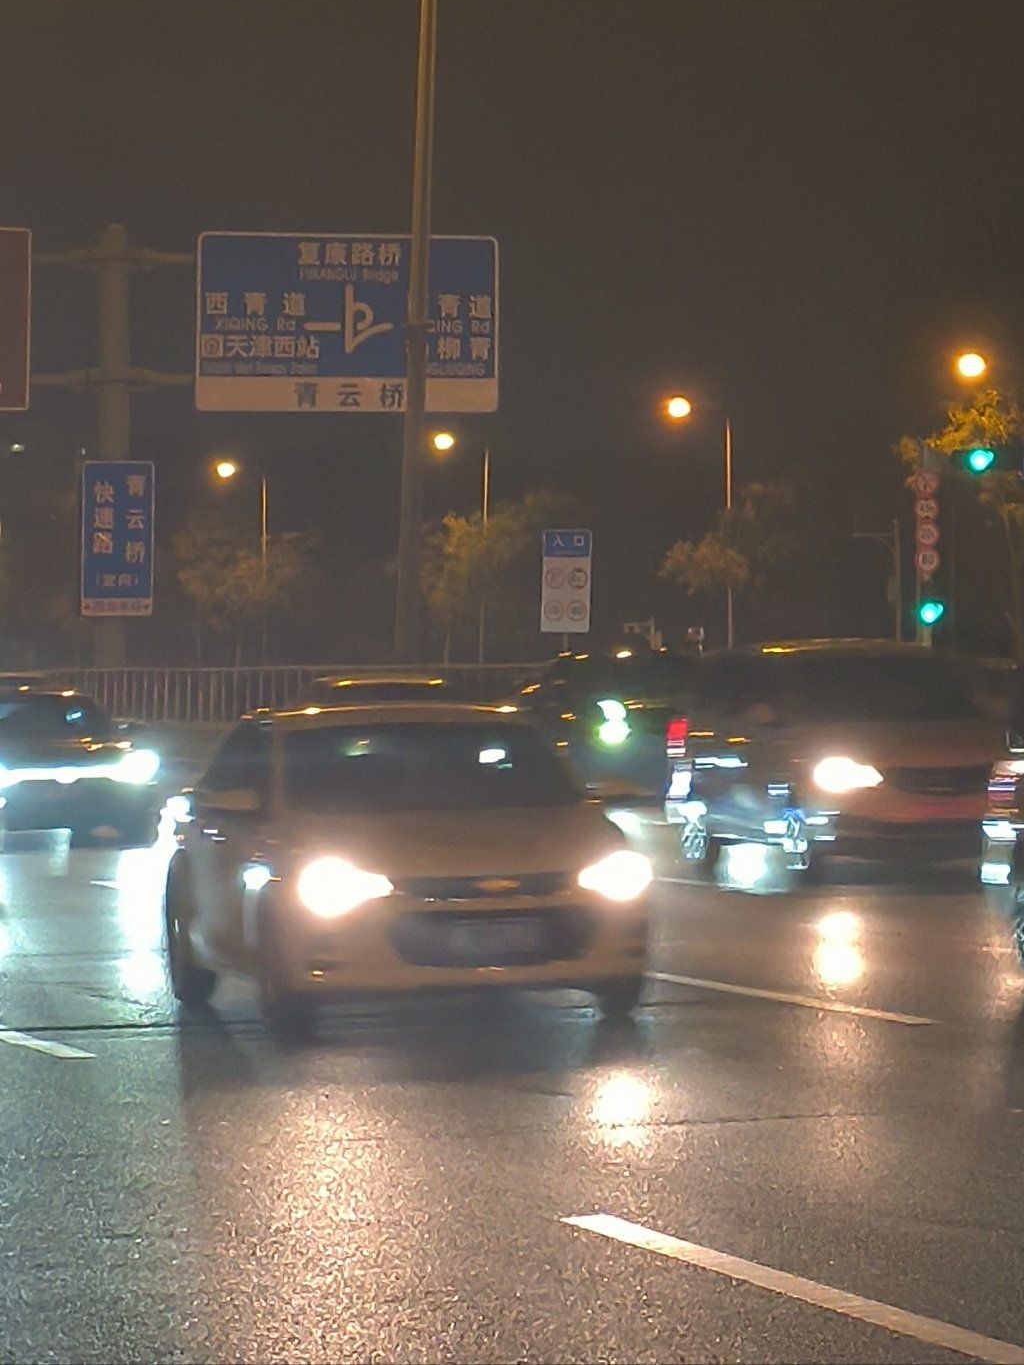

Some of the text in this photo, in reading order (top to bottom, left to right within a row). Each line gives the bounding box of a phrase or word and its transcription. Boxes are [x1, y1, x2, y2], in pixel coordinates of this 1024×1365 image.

[297, 240, 402, 266] 复康路桥
[205, 292, 306, 317] 西青道
[437, 293, 493, 319] 青道
[215, 318, 296, 331] XIQING Rd
[470, 319, 491, 333] Rd
[226, 334, 320, 359] 天津西站
[426, 336, 492, 361] 柳青
[295, 382, 405, 409] 青云桥
[92, 480, 115, 554] 快速路
[124, 474, 146, 565] 青云桥
[552, 534, 585, 547] 入口
